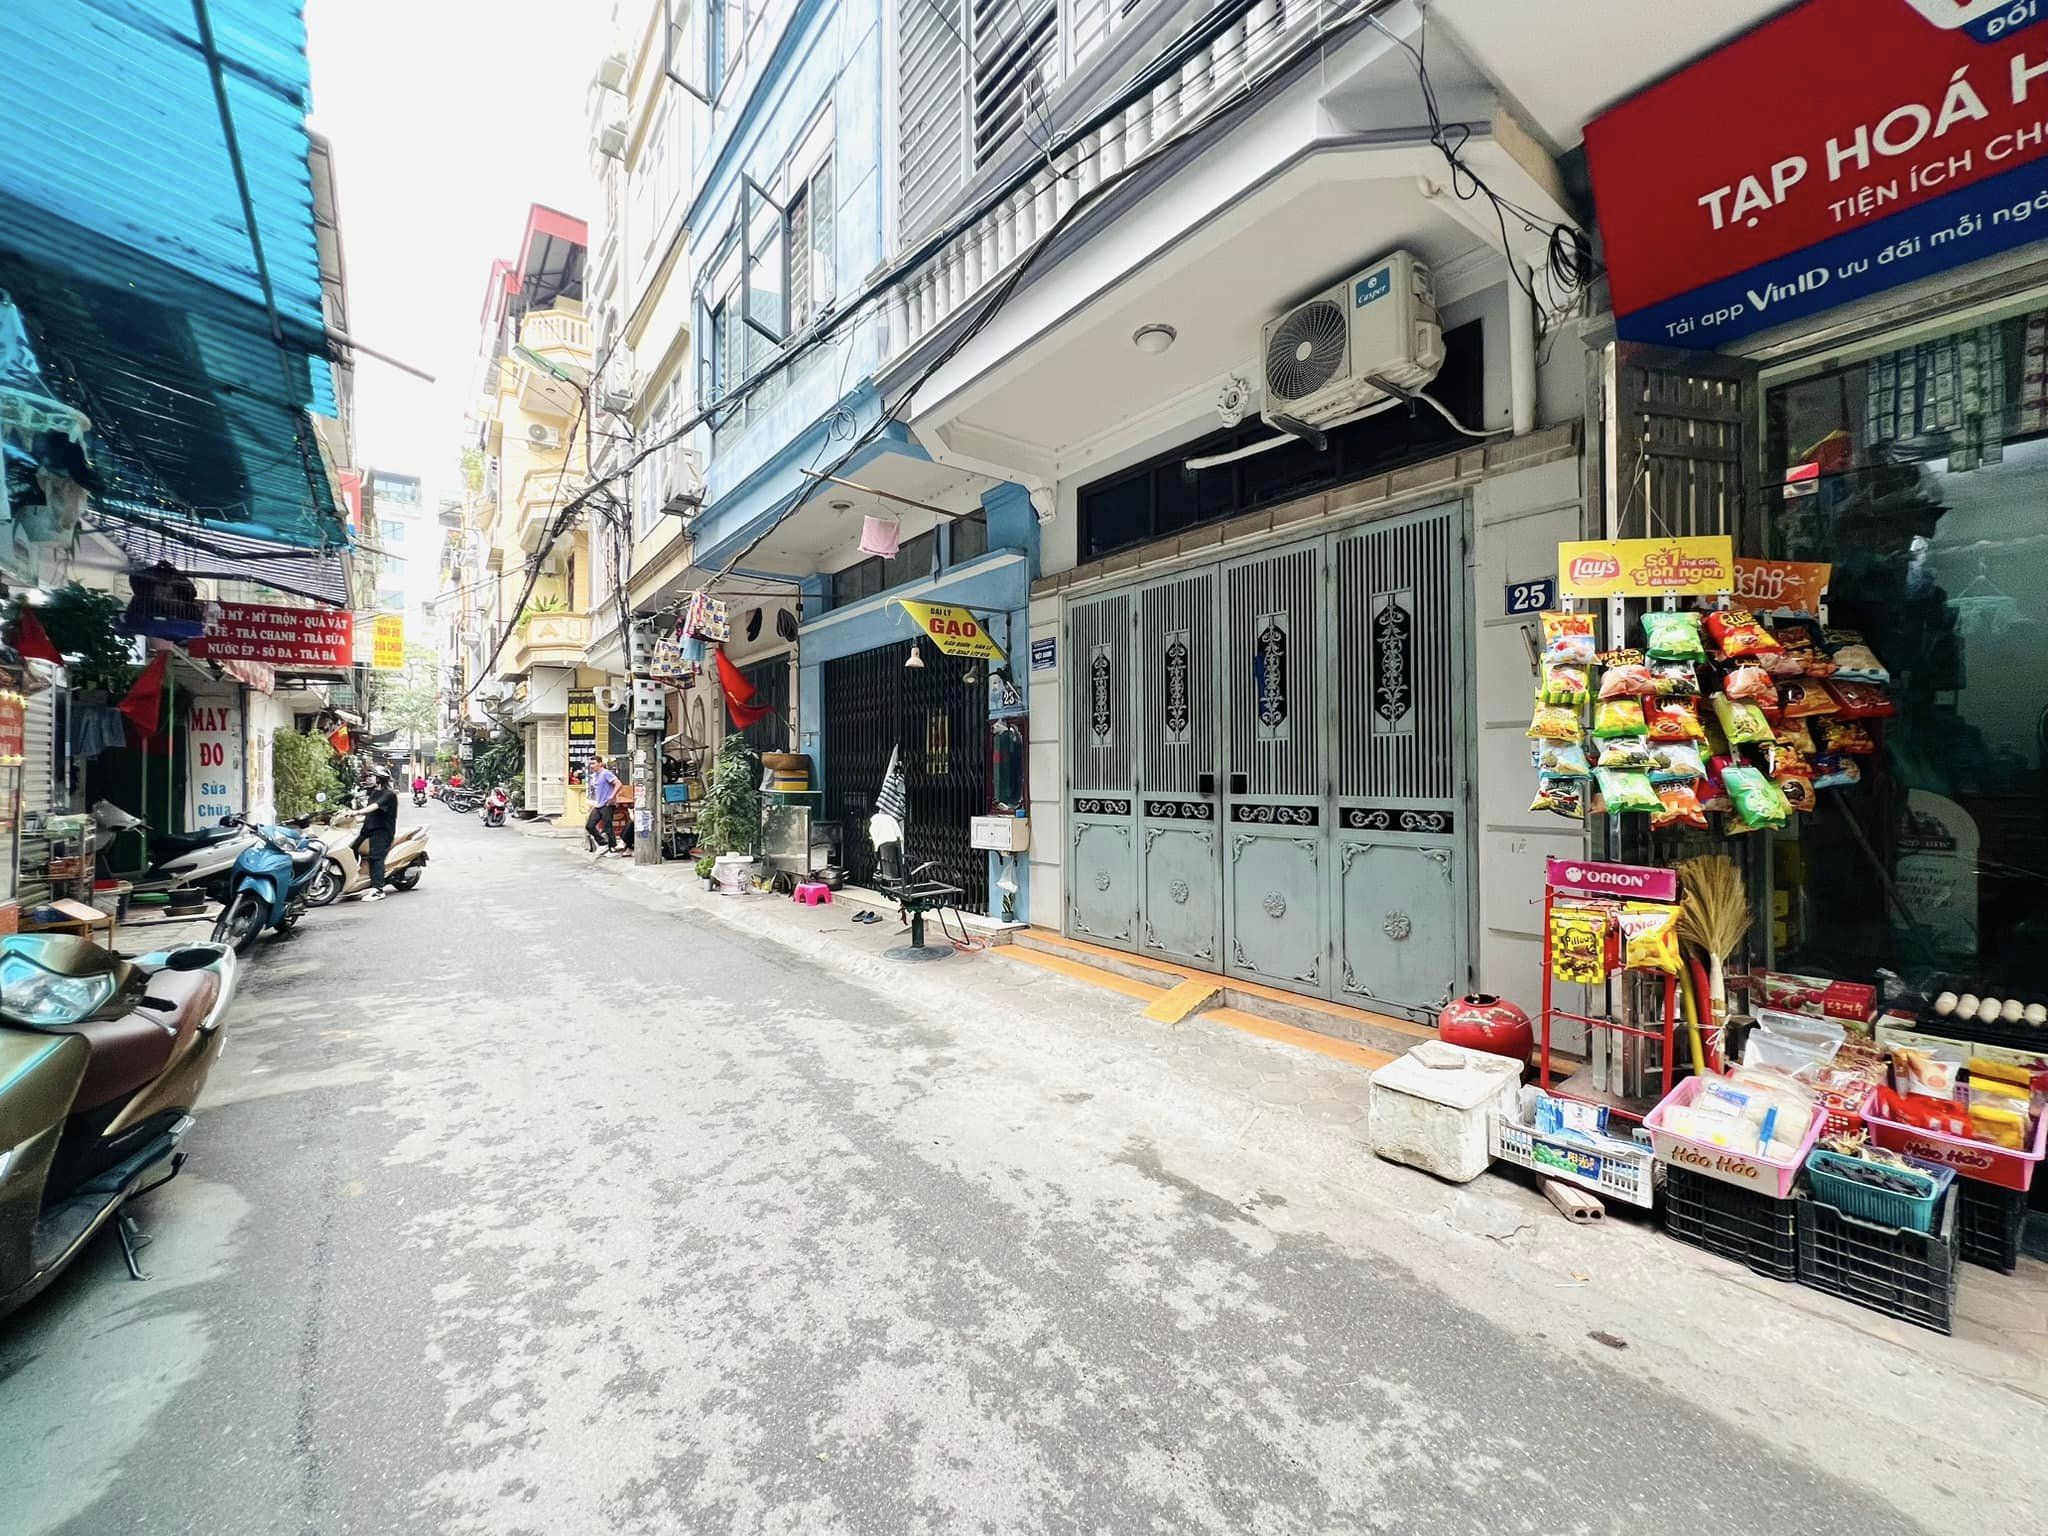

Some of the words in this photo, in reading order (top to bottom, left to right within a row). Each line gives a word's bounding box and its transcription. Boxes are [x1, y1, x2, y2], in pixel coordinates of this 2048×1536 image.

[1697, 155, 1809, 231] TẠP
[1825, 64, 1990, 182] HOÁ
[1828, 180, 1899, 223] TIỆN
[1911, 149, 1972, 193] ÍCH
[1985, 121, 2048, 161] CH
[1665, 316, 1695, 338] Tải
[1701, 303, 1744, 326] app
[1746, 267, 1830, 312] VinID
[1838, 258, 1869, 279] ưu
[1877, 236, 1921, 265] đãi
[1930, 214, 1983, 247] mỗi
[1679, 566, 1725, 585] ngon
[1513, 584, 1547, 610] 25
[259, 629, 296, 642] CHANH
[191, 707, 229, 732] MAY
[200, 742, 224, 767] ĐO
[1587, 871, 1643, 887] ORION
[1672, 1145, 1712, 1169] Hảo
[1716, 1154, 1760, 1179] Hảo
